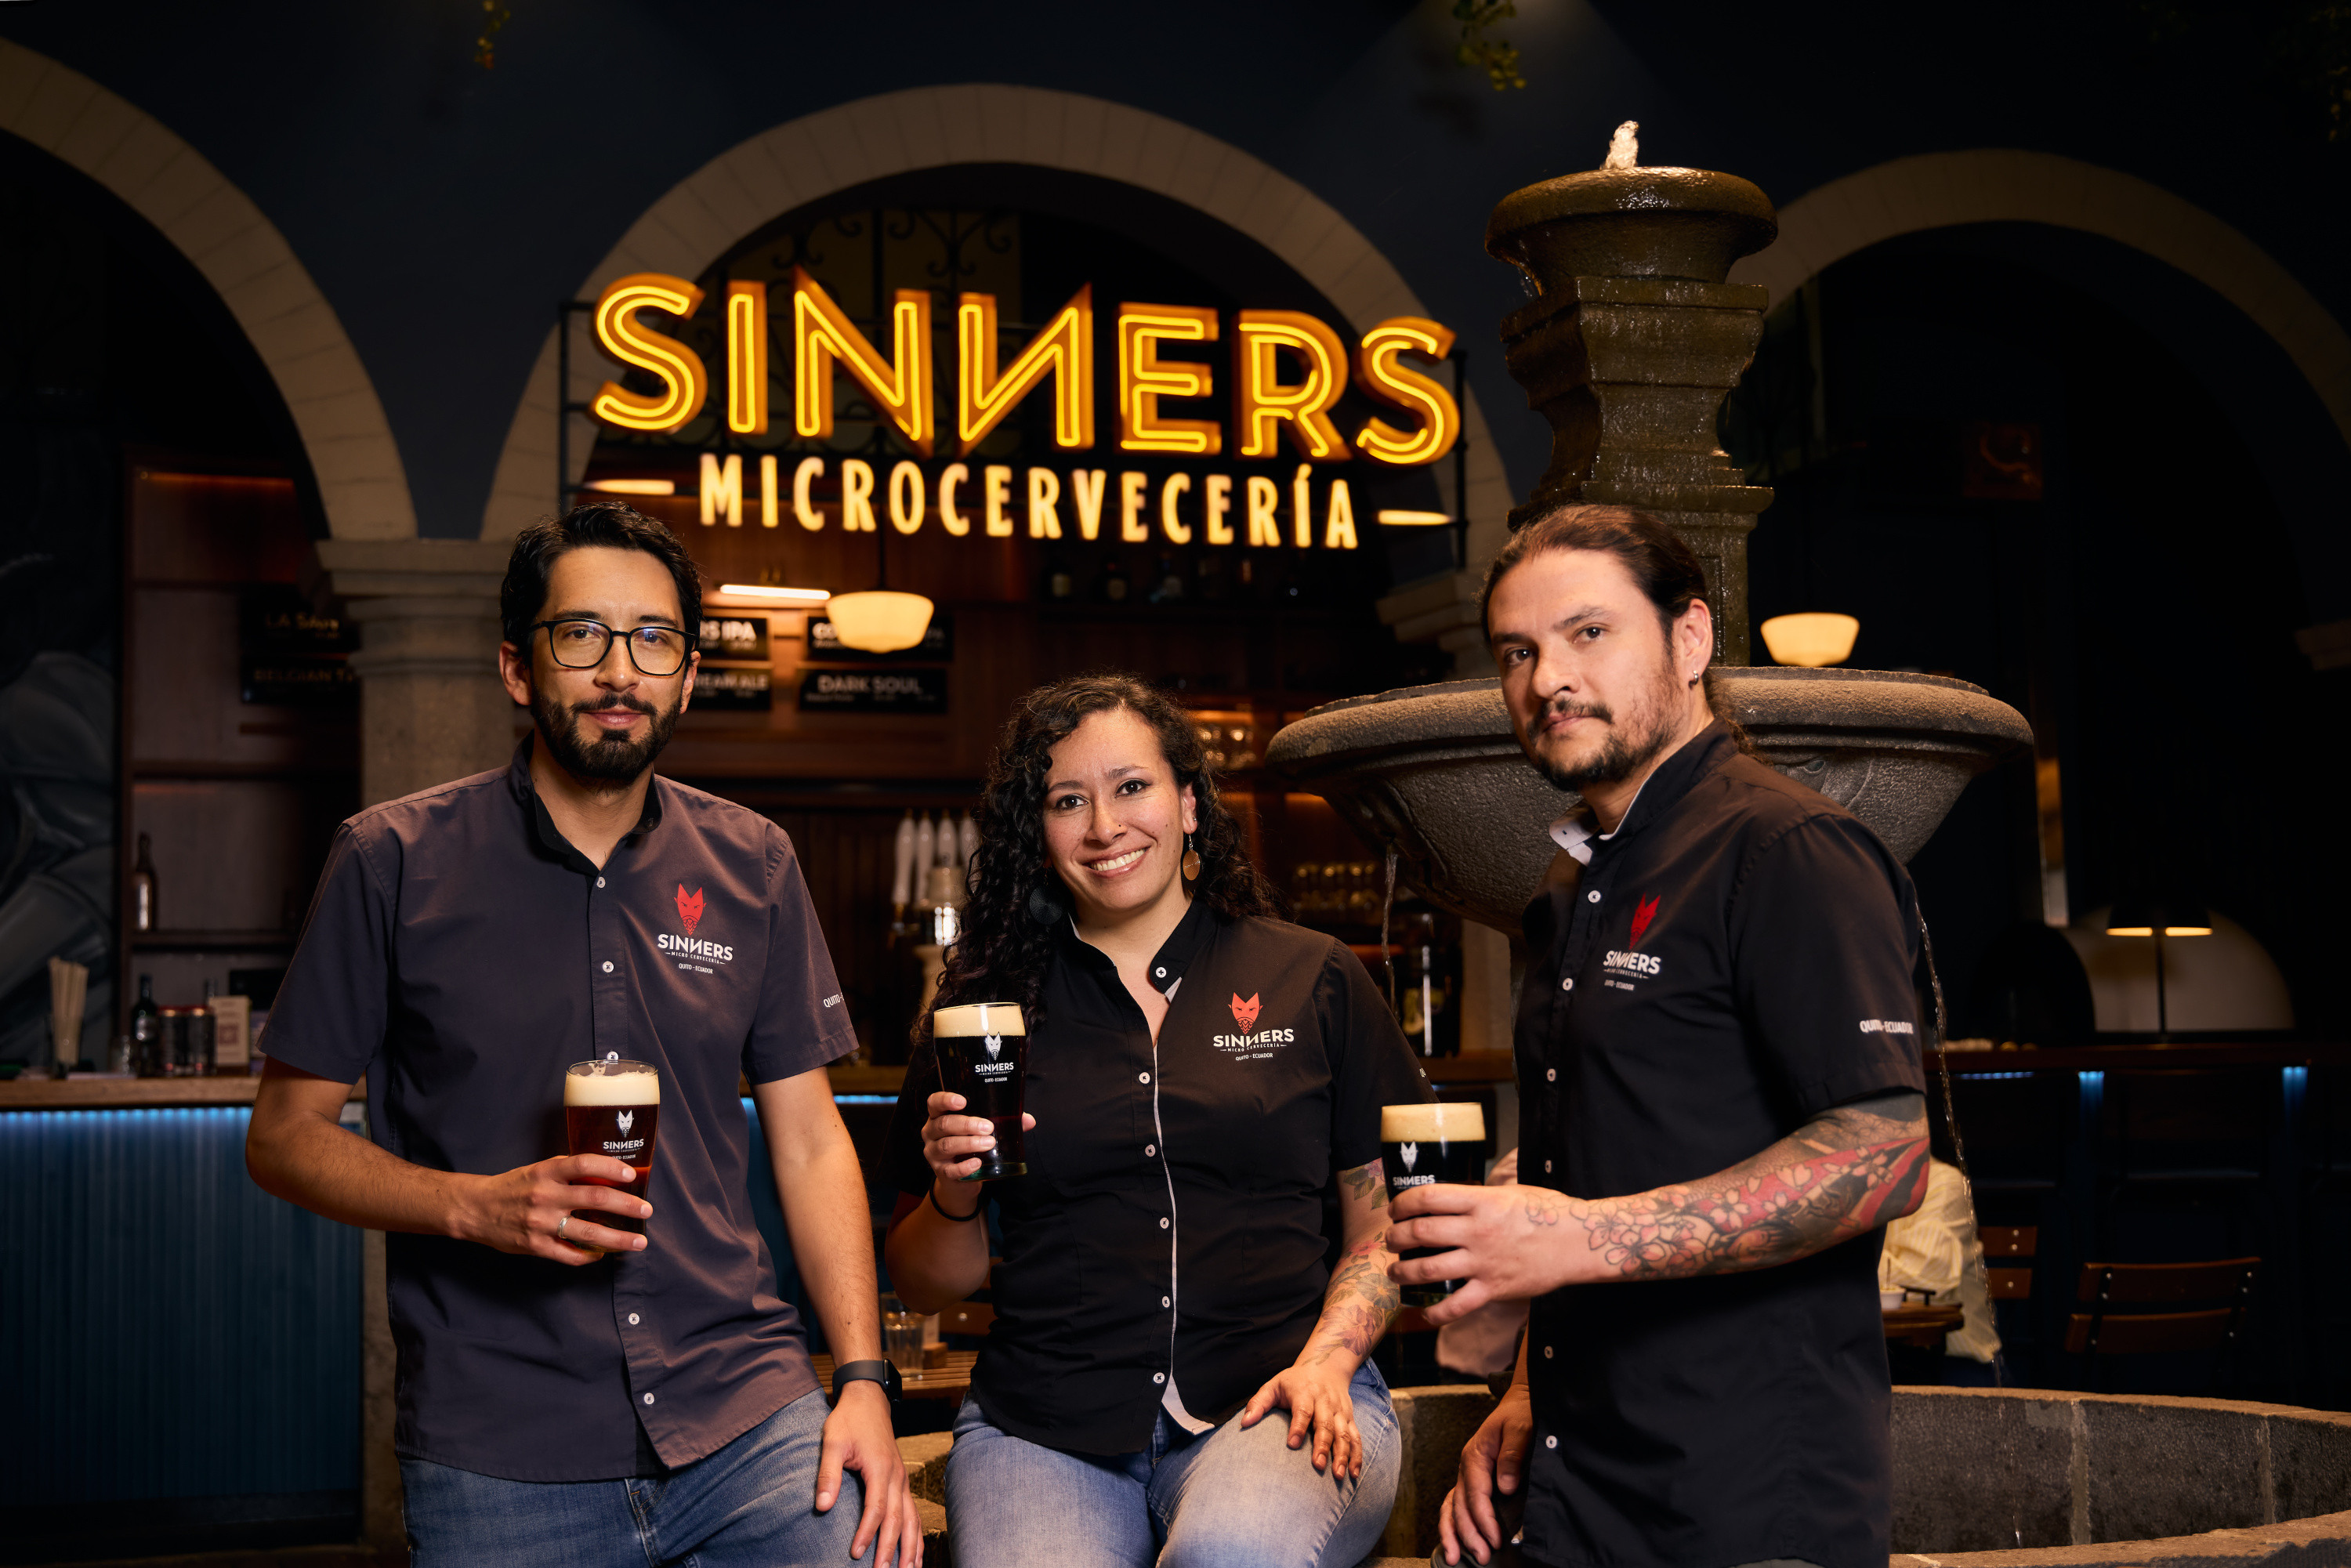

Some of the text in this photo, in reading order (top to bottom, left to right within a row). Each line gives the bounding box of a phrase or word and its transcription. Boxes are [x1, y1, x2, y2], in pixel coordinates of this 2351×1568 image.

[592, 265, 1459, 465] SINNERS
[699, 453, 1358, 549] MICROCERVECERÍA
[817, 674, 923, 696] DARK SOUL
[657, 933, 734, 961] SINNERS
[695, 965, 713, 974] ECUADOR
[1213, 1028, 1295, 1048] SINNERS
[975, 1062, 1014, 1073] SINNERS
[603, 1139, 644, 1150] SINNERS
